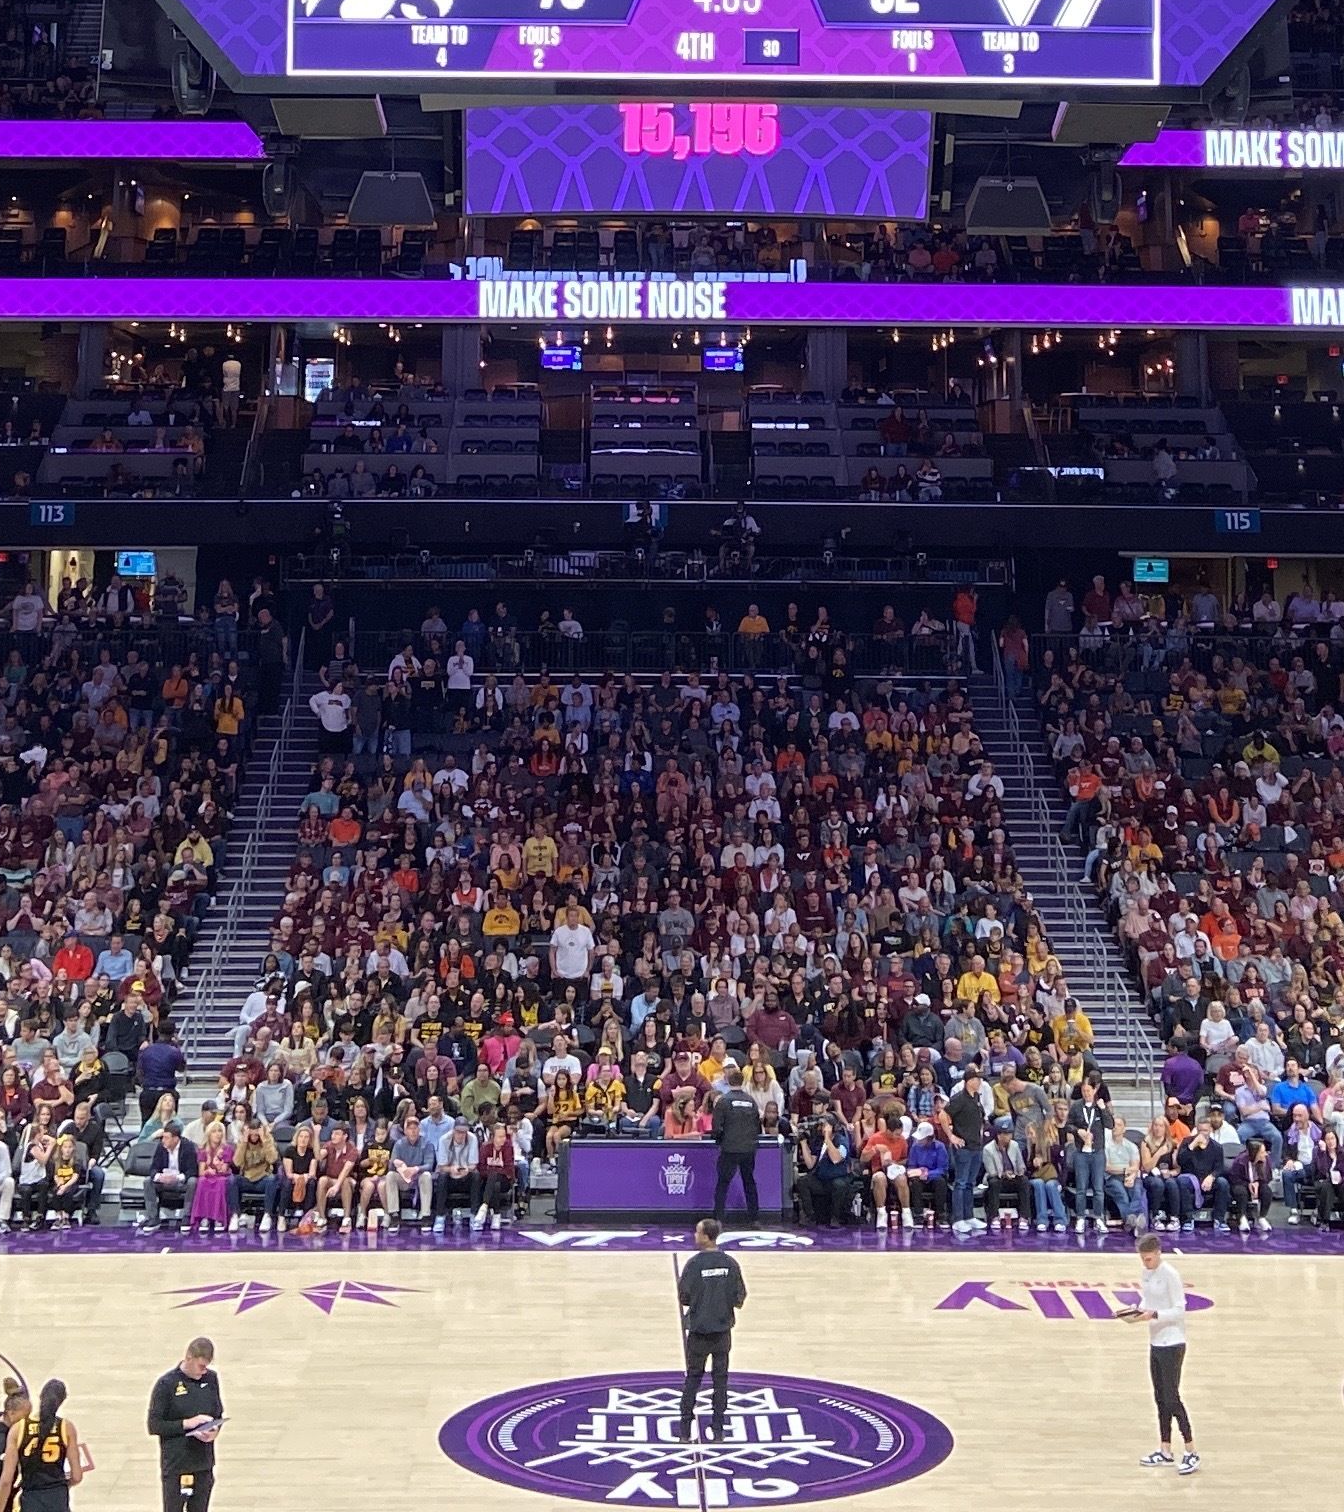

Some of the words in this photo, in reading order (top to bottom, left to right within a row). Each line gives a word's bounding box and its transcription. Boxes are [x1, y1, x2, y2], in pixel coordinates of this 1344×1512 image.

[411, 25, 451, 45] TEAM
[452, 26, 468, 45] TO
[519, 26, 561, 46] FOULS
[892, 30, 934, 50] FOULS
[982, 31, 1021, 51] TEAM
[1022, 32, 1040, 51] TO
[676, 32, 716, 62] 4TH
[763, 40, 780, 58] 30
[435, 48, 447, 68] 4
[533, 49, 544, 68] 2
[907, 53, 916, 72] 1
[1003, 54, 1014, 73] 3
[618, 101, 780, 159] 15,196
[1205, 129, 1282, 169] MAKE
[478, 280, 560, 319] MAKE
[564, 280, 643, 320] SOME
[647, 281, 726, 320] NOISE
[40, 504, 65, 523] 113
[1224, 512, 1251, 530] 115
[667, 1153, 685, 1165] ally
[606, 1472, 800, 1508] ally
